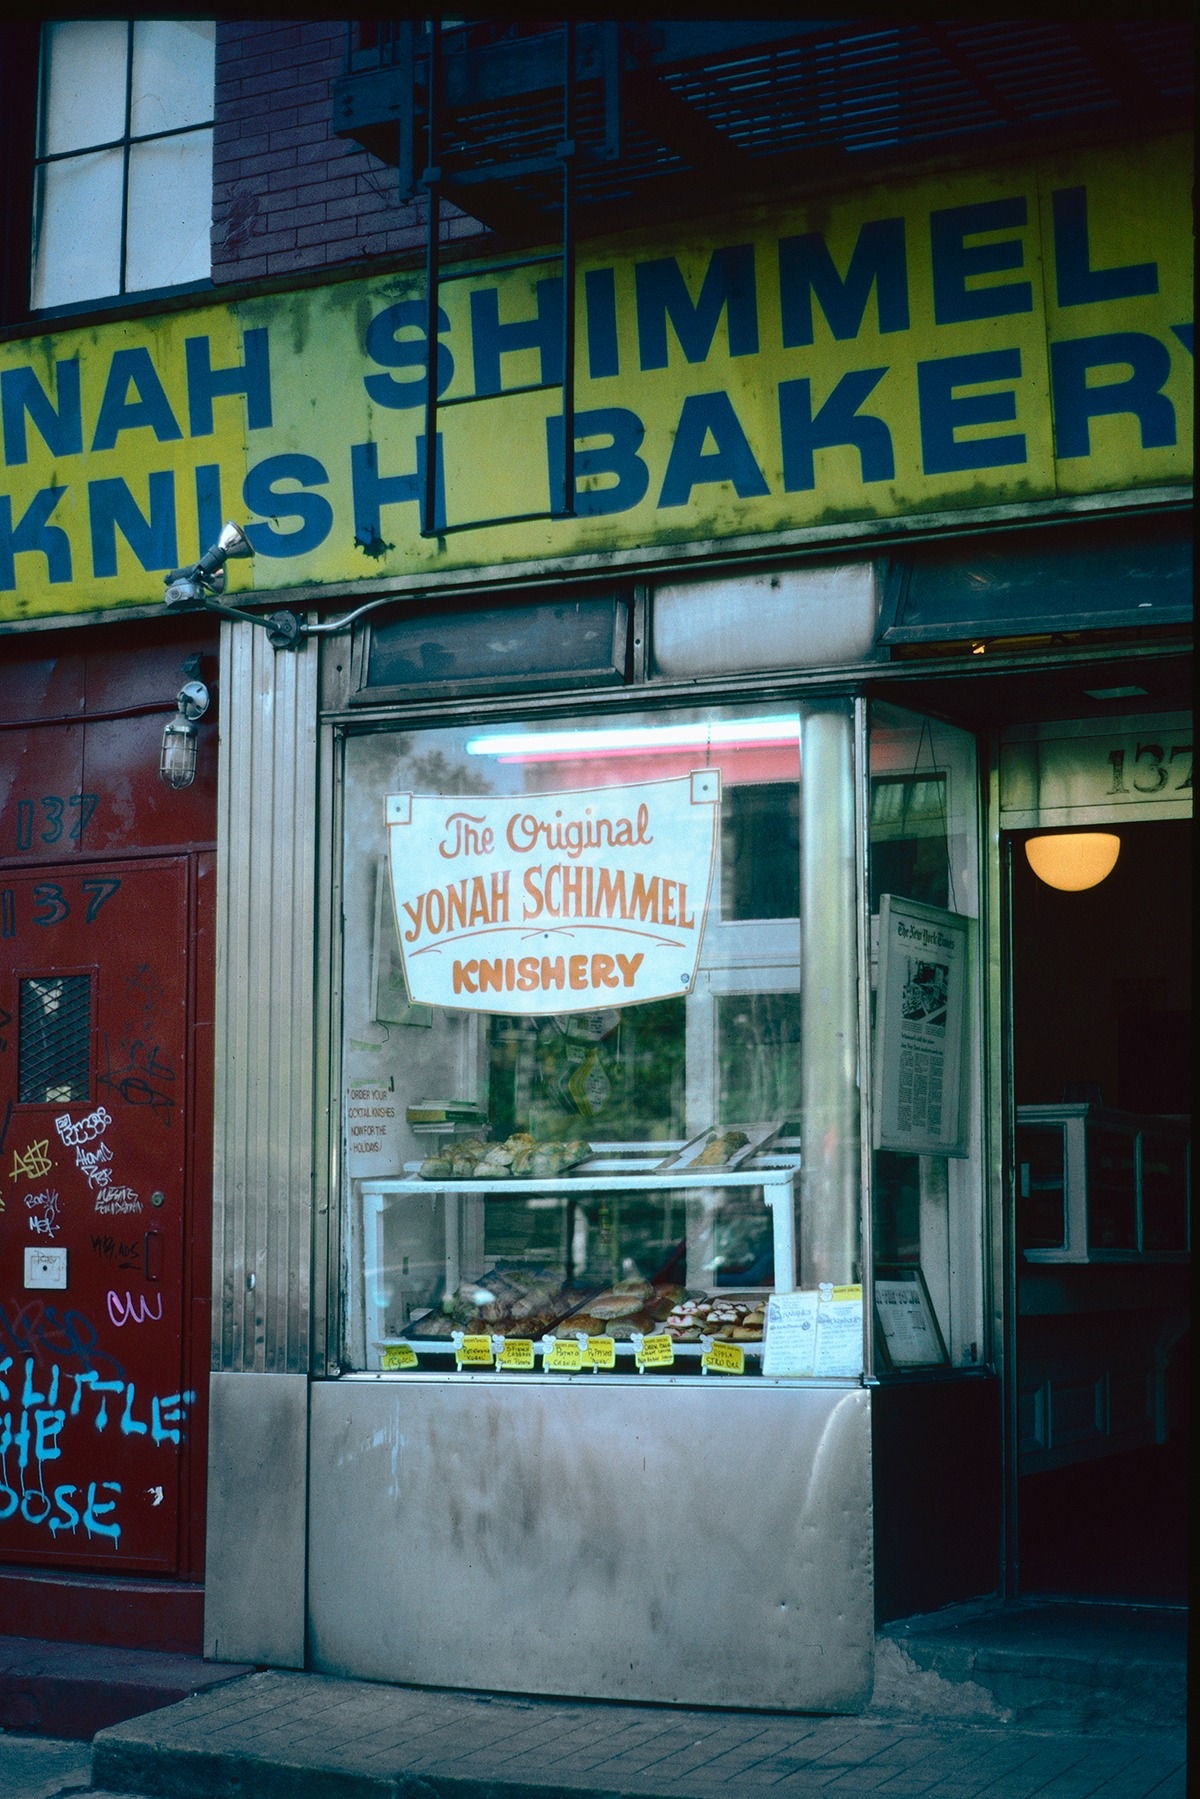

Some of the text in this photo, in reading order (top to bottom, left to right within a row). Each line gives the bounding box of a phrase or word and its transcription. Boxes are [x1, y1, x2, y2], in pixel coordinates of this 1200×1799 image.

[0, 185, 1159, 466] NAH SHIMMEL
[0, 432, 446, 591] KNISH
[17, 794, 100, 850] 137
[438, 803, 654, 859] The Original
[2, 879, 121, 939] 137
[402, 863, 695, 942] YONAH SCHIMMEL
[453, 953, 645, 994] KNISHERY
